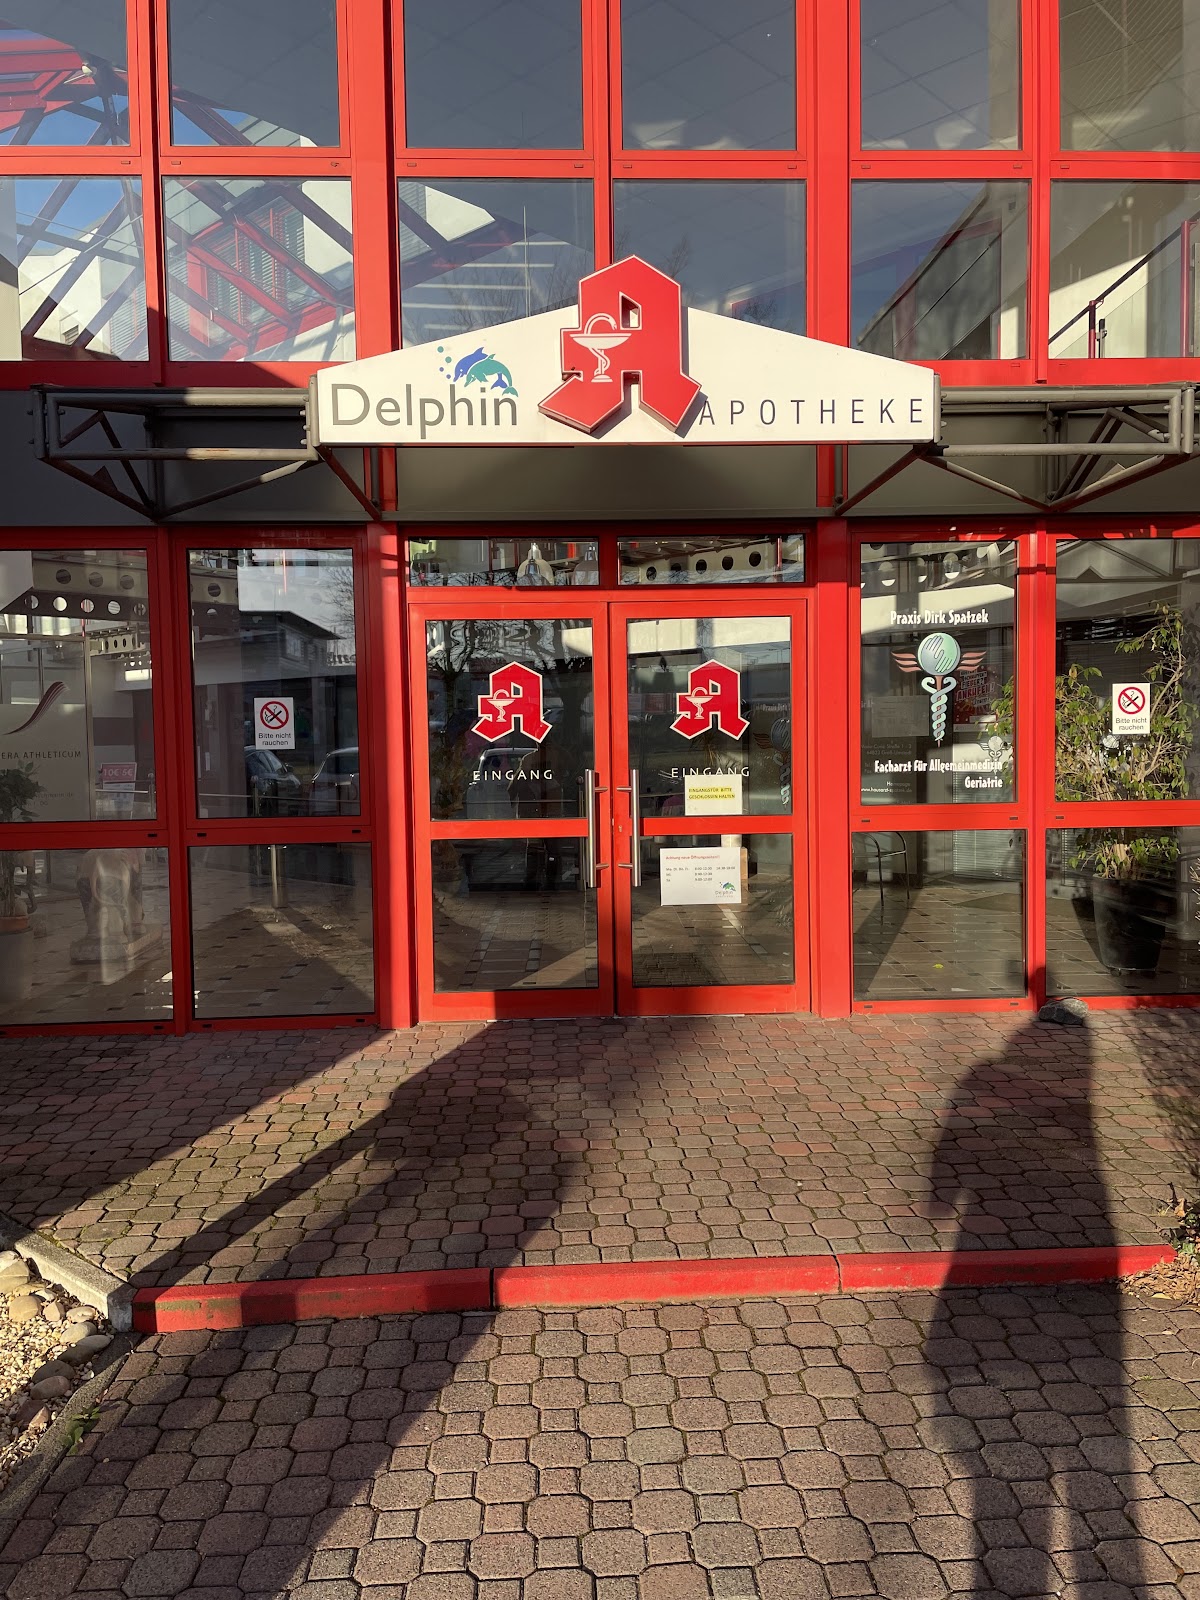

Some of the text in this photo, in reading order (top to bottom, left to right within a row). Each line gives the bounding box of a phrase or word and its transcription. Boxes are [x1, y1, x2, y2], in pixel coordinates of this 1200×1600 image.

[331, 383, 518, 440] Delphin
[699, 398, 923, 426] APOTHEKE
[890, 608, 989, 625] Praxis Dirk Spatzek
[23, 750, 82, 759] ATHLETICUM
[874, 758, 1003, 773] Facharzt für Allgemeinmedizin
[473, 769, 553, 781] EINGANG
[965, 775, 1003, 789] Geriatrie
